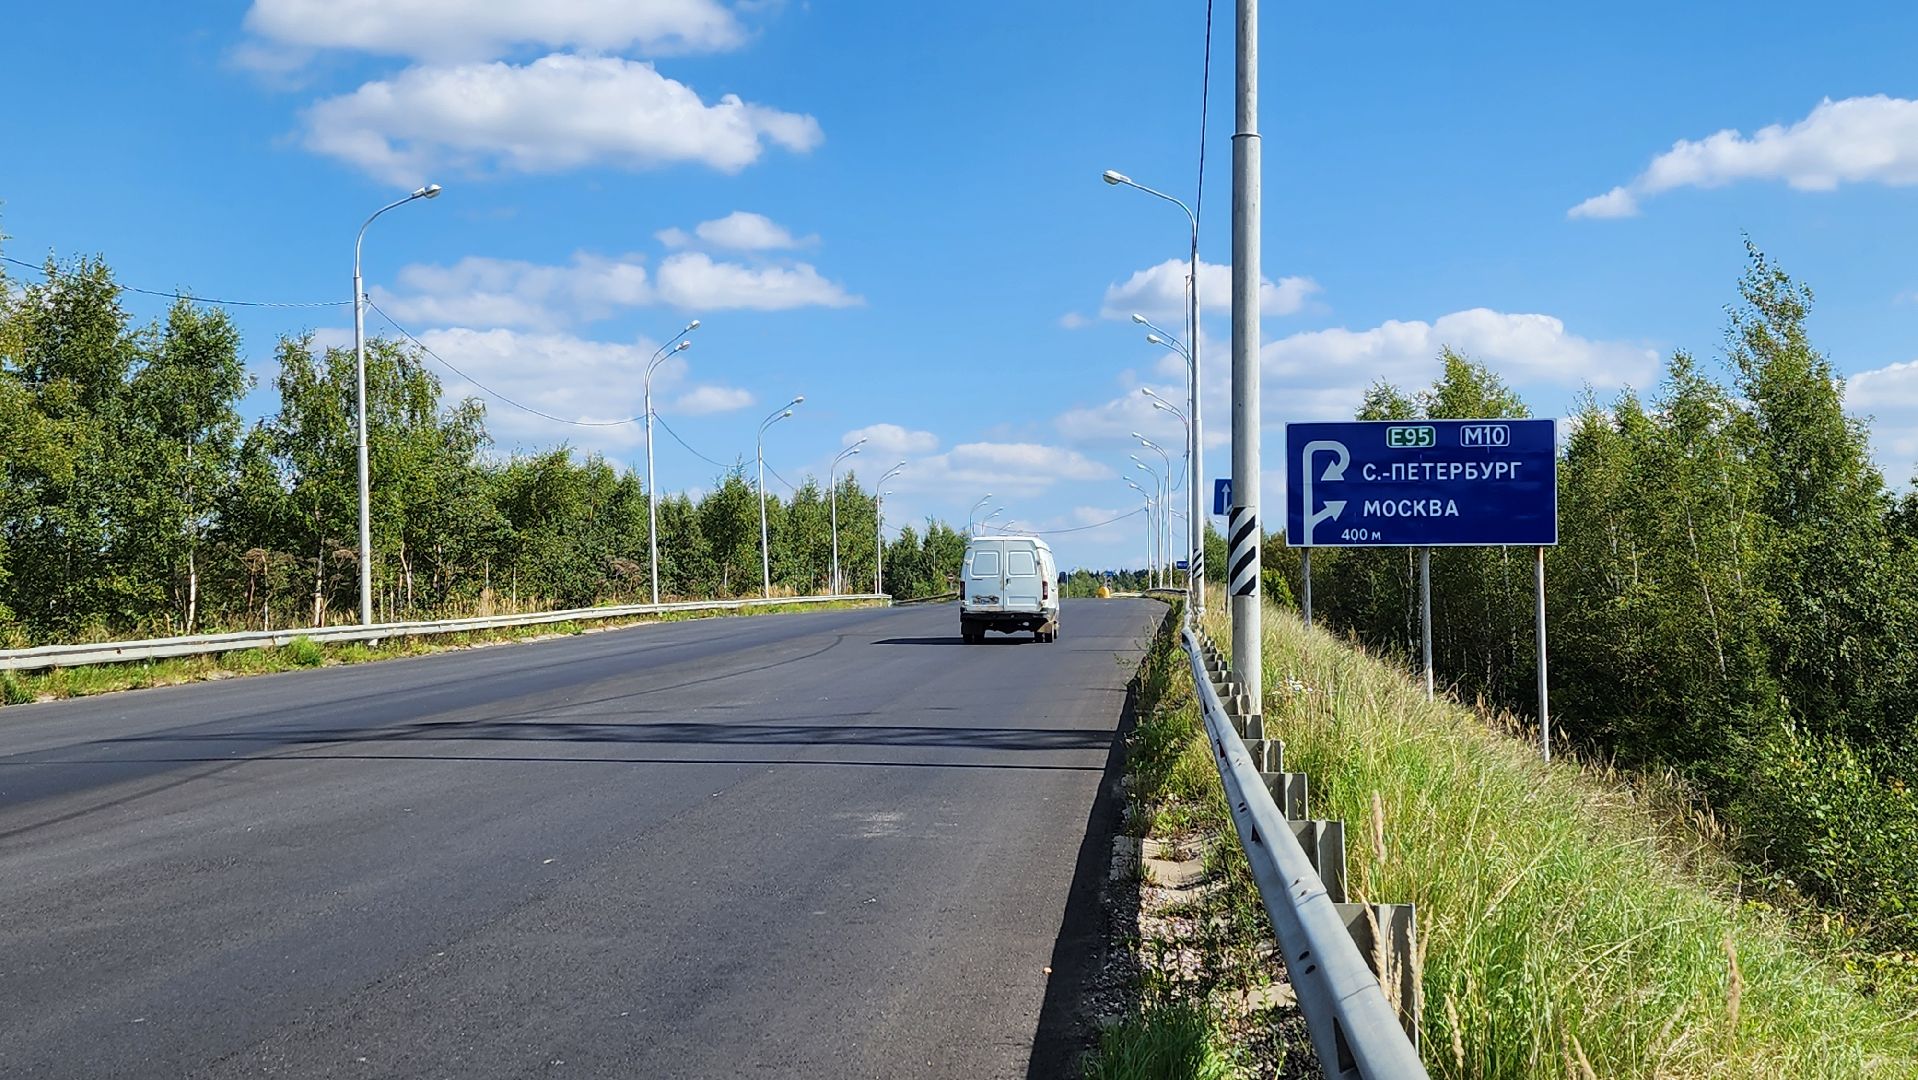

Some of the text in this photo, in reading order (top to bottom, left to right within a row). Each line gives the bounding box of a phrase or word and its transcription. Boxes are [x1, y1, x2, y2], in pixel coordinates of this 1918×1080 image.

[1390, 428, 1430, 446] E95
[1464, 427, 1505, 445] М10
[1362, 461, 1522, 481] С.-ПЕТЕРБУРГ
[1363, 500, 1460, 517] МОСКВА
[1341, 529, 1382, 541] 400 м
